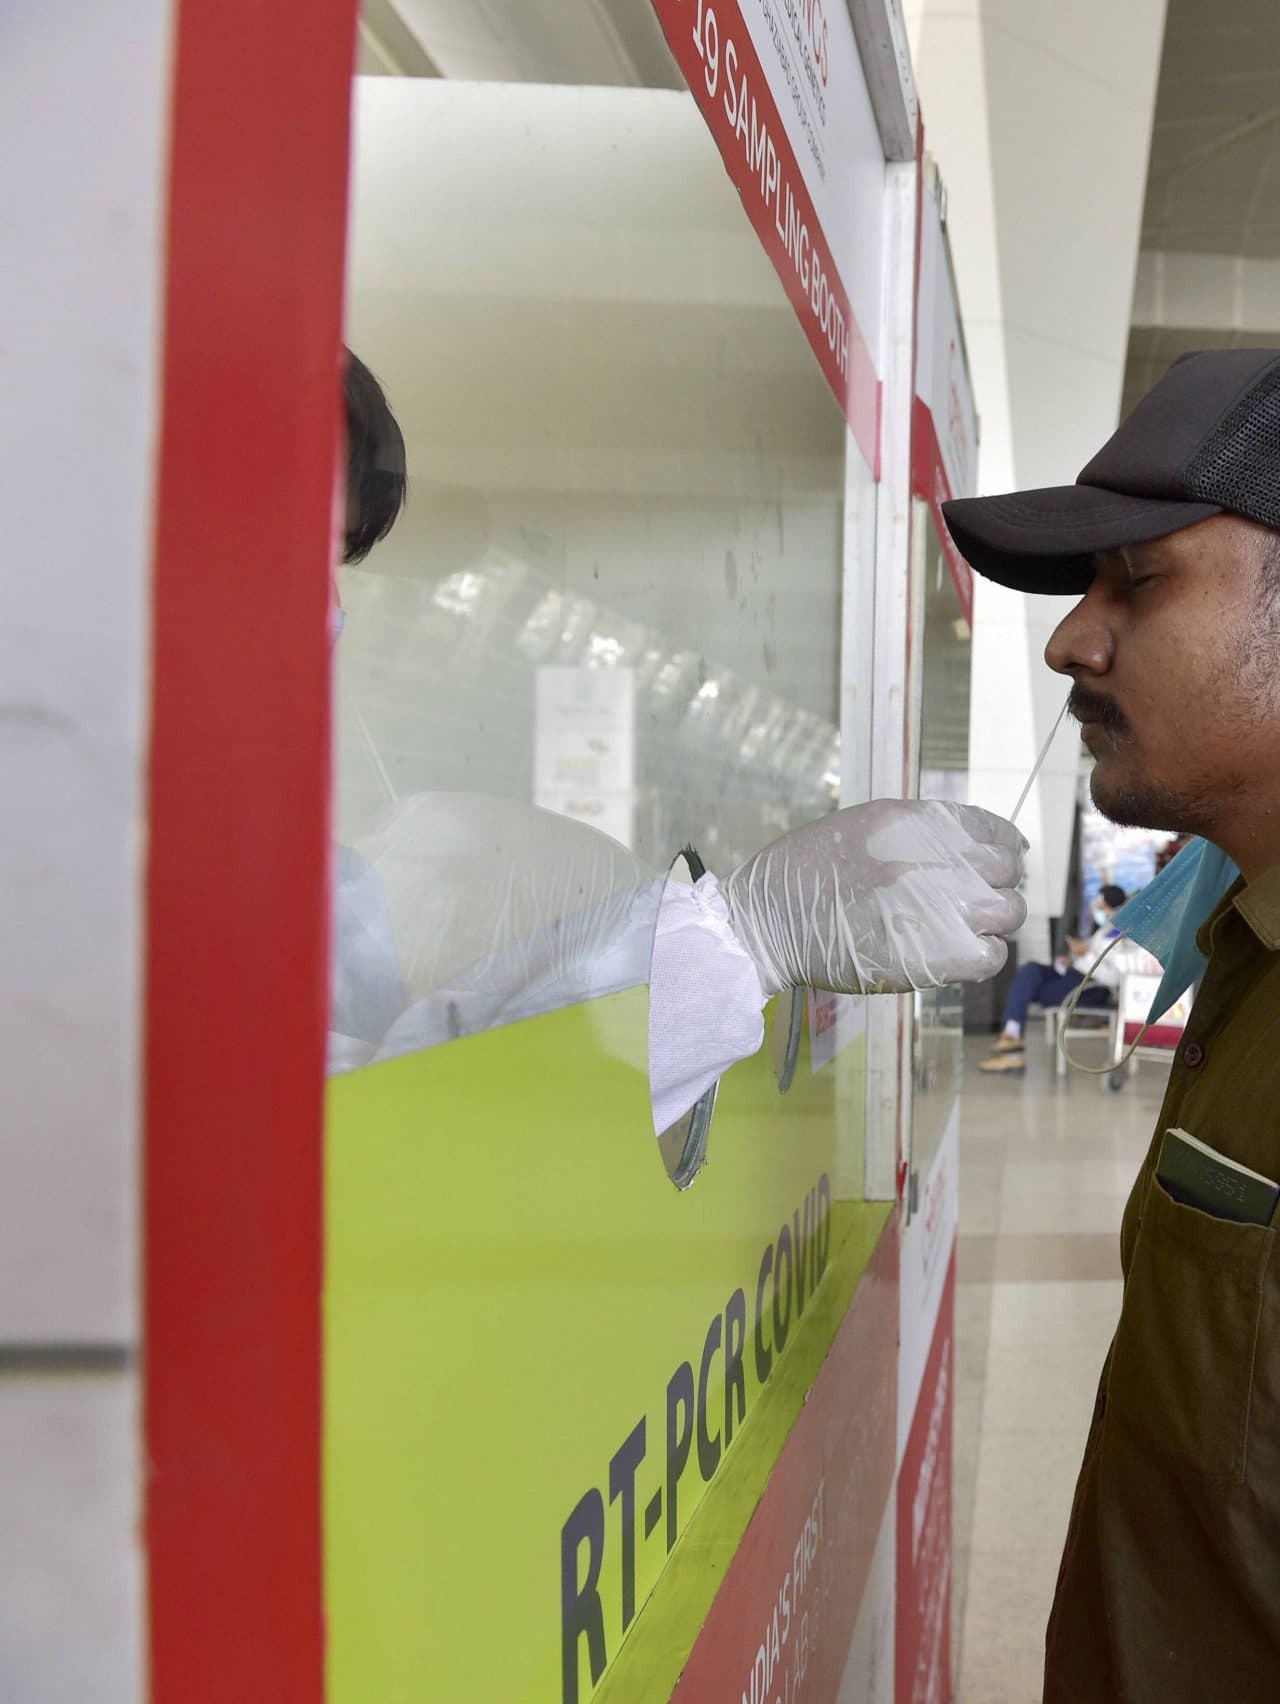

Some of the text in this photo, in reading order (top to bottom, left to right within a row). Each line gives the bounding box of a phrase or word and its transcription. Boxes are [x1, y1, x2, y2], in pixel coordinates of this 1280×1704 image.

[723, 38, 810, 295] SAMPLING
[811, 247, 849, 383] BOOTH
[562, 1172, 831, 1704] RT-PCR COVID
[793, 1477, 825, 1616] FIRST
